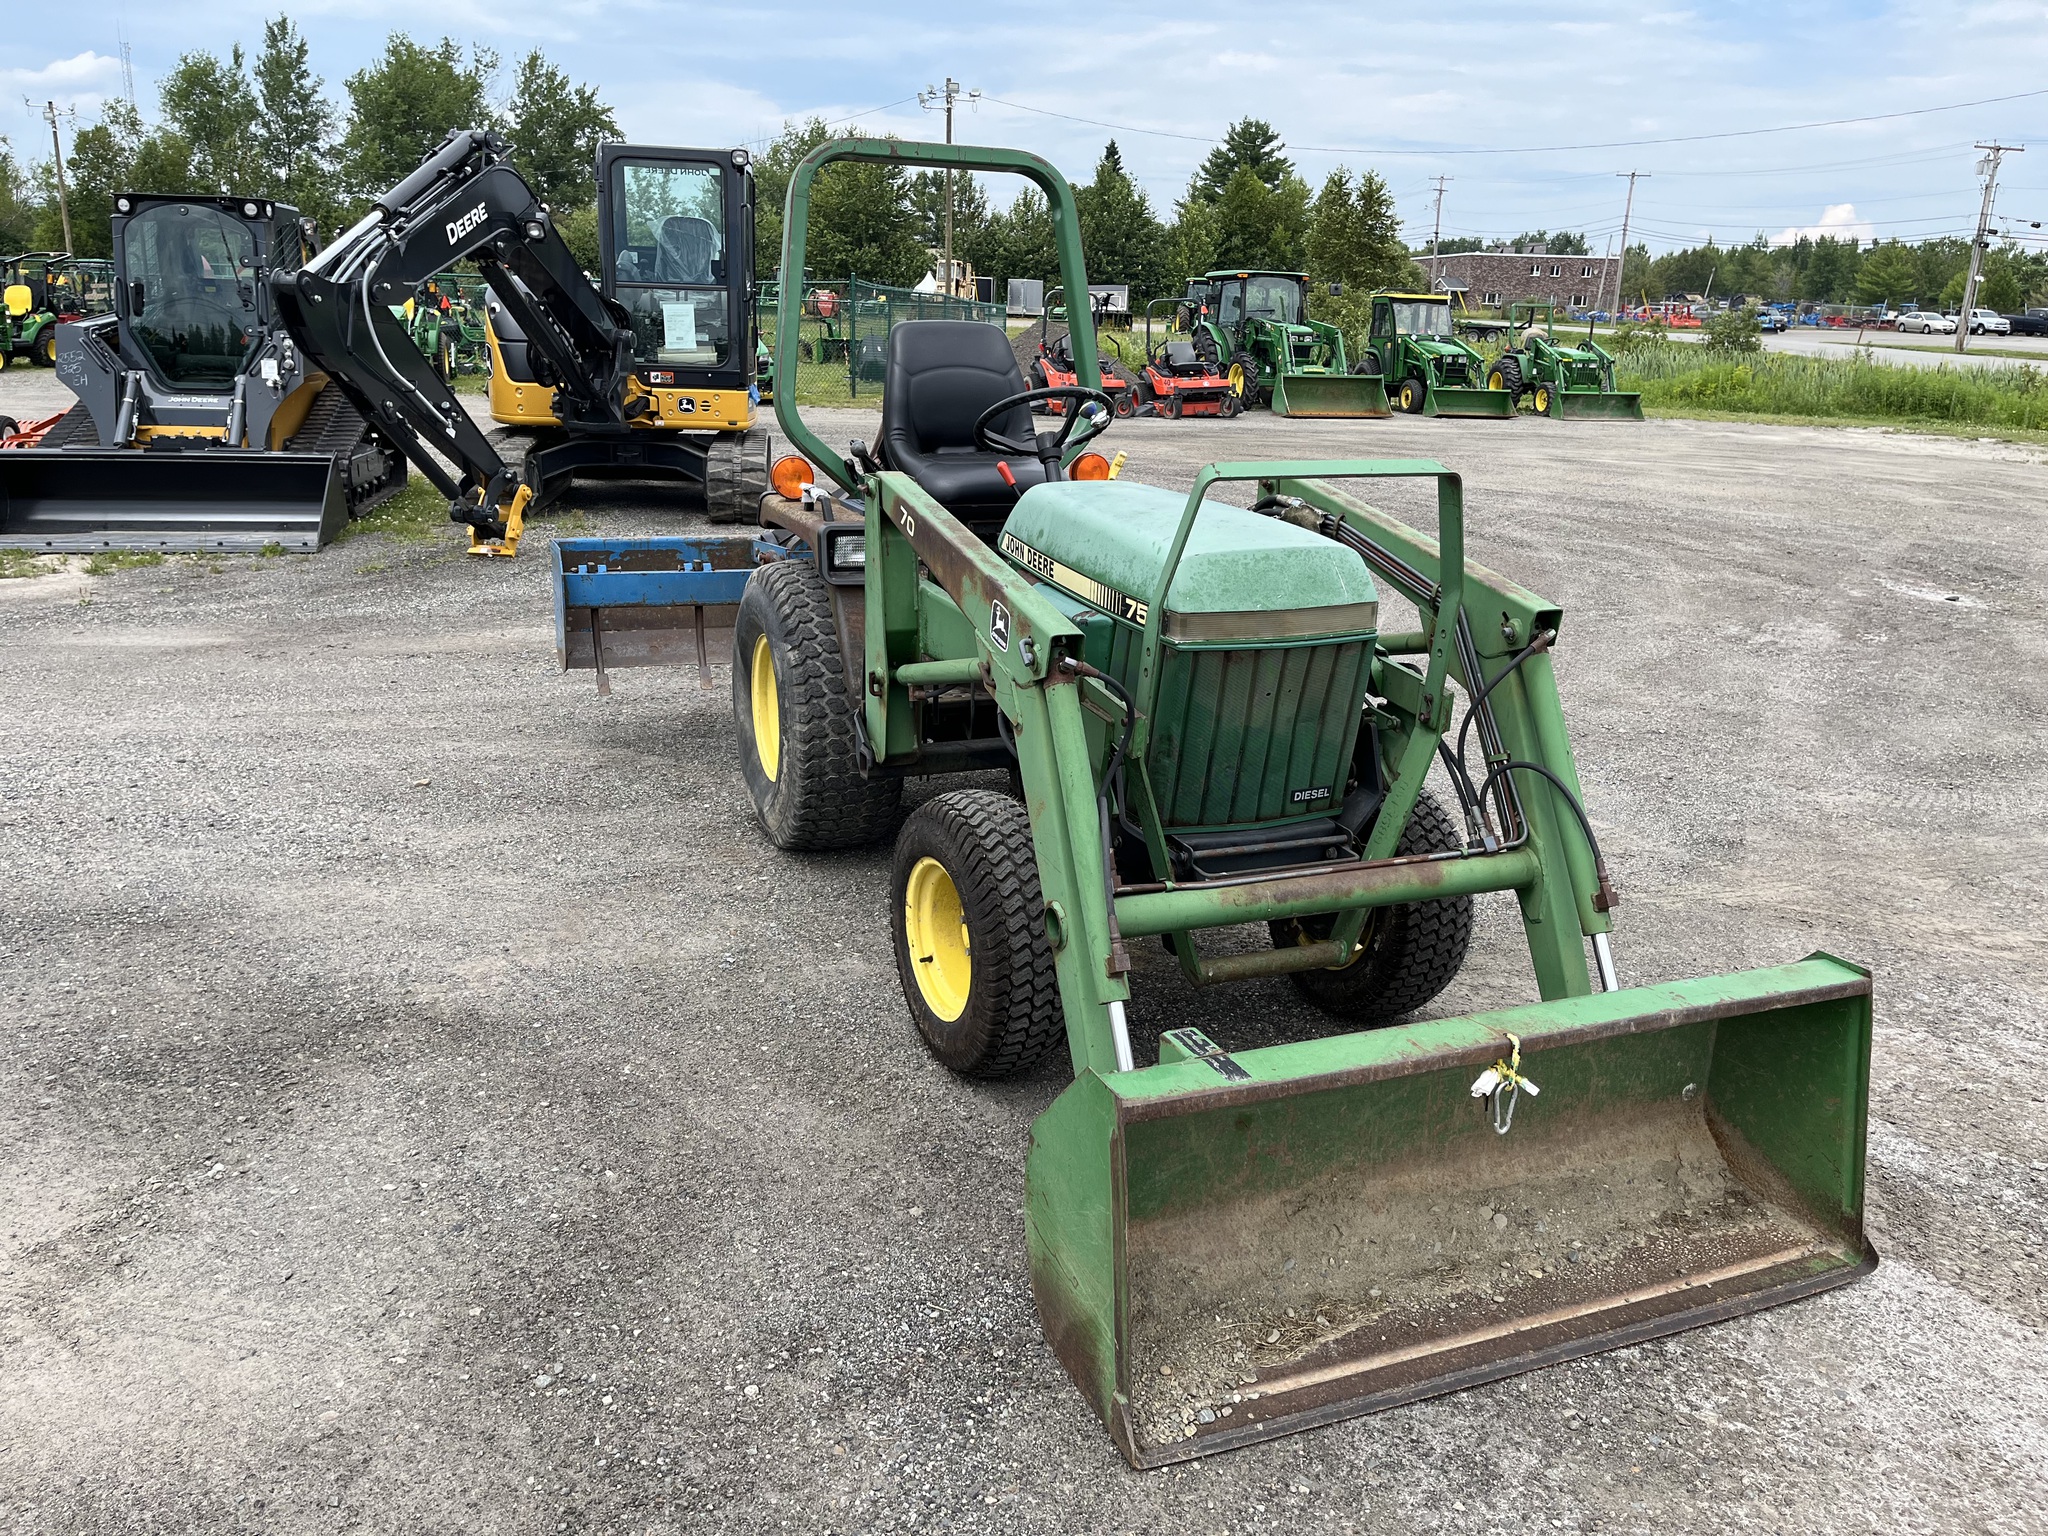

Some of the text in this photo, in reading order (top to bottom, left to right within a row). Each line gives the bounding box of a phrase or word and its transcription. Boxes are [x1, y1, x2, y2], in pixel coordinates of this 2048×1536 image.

[445, 201, 489, 246] DEERE
[58, 350, 86, 363] 2552
[60, 362, 82, 375] 325
[73, 373, 88, 386] EH
[191, 396, 219, 404] DEERE
[900, 504, 915, 537] 70
[1005, 535, 1055, 579] JOHN DEERE
[1294, 788, 1330, 801] DIESEL
